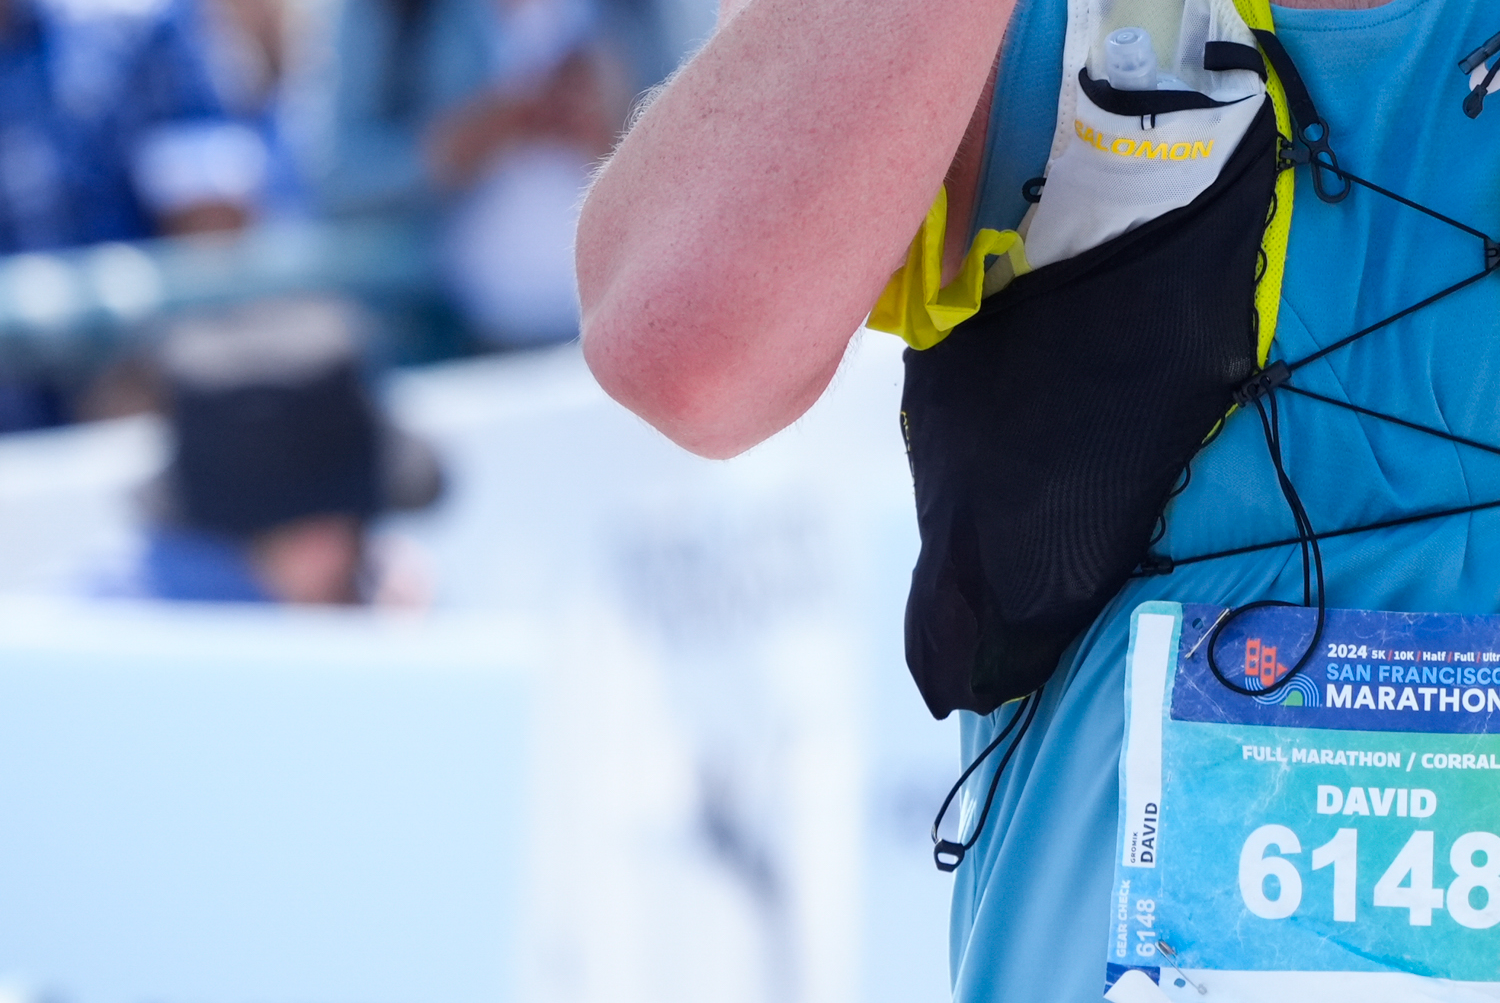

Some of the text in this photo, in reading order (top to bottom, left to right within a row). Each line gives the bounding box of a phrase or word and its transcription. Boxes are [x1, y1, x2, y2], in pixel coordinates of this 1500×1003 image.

[1074, 119, 1214, 161] SALOMON
[1327, 643, 1368, 659] 2024
[1371, 650, 1386, 660] 5K
[1393, 650, 1415, 661] 10K
[1422, 651, 1446, 662] Half
[1454, 652, 1475, 662] Full
[1326, 663, 1371, 682] SAN
[1242, 745, 1287, 762] FULL
[1292, 748, 1400, 768] MARATHON
[1421, 753, 1500, 770] CORRAL
[1316, 784, 1437, 818] DAVID
[1130, 831, 1139, 864] GROMIK
[1140, 802, 1158, 864] DAVID
[1116, 879, 1131, 958] GEAR CHECK
[1136, 898, 1156, 958] 6148
